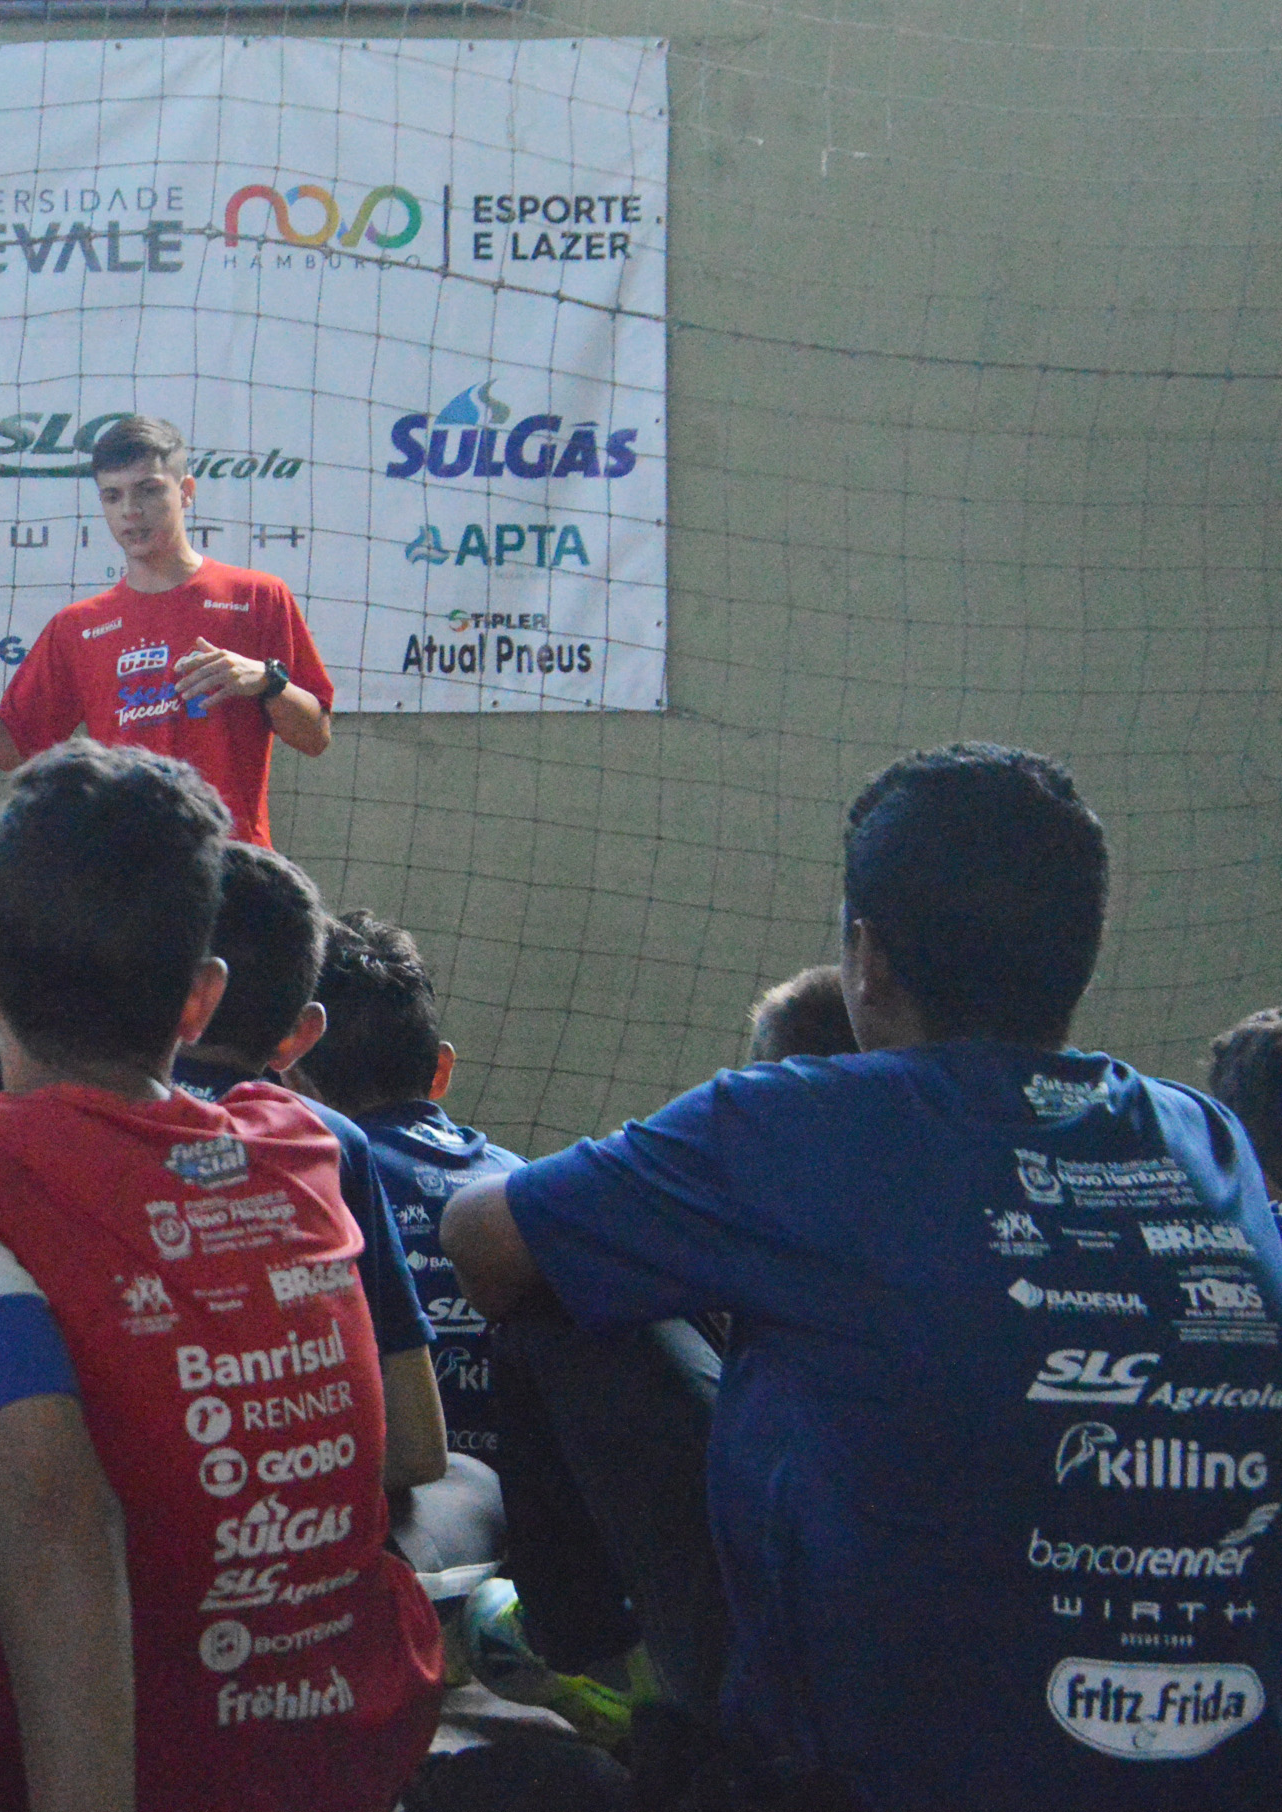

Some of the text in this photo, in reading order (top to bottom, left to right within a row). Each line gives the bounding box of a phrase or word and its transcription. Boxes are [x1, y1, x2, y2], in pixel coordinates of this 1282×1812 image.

[473, 194, 642, 224] ESPORTE
[473, 231, 631, 261] E LAZER
[185, 447, 304, 481] ícola
[10, 525, 306, 549] WITH
[455, 523, 591, 568] APTA
[203, 599, 250, 613] Banrisul
[470, 613, 546, 629] TIPLER
[403, 633, 593, 675] Atual Pneus
[114, 698, 182, 727] Torcedor
[1139, 1224, 1256, 1253] BRASIL
[175, 1317, 346, 1391] Banrisul
[1036, 1349, 1161, 1385] SLC
[242, 1380, 354, 1431] RENNER
[256, 1433, 357, 1484] GLOBO
[1028, 1528, 1255, 1578] bancorenner
